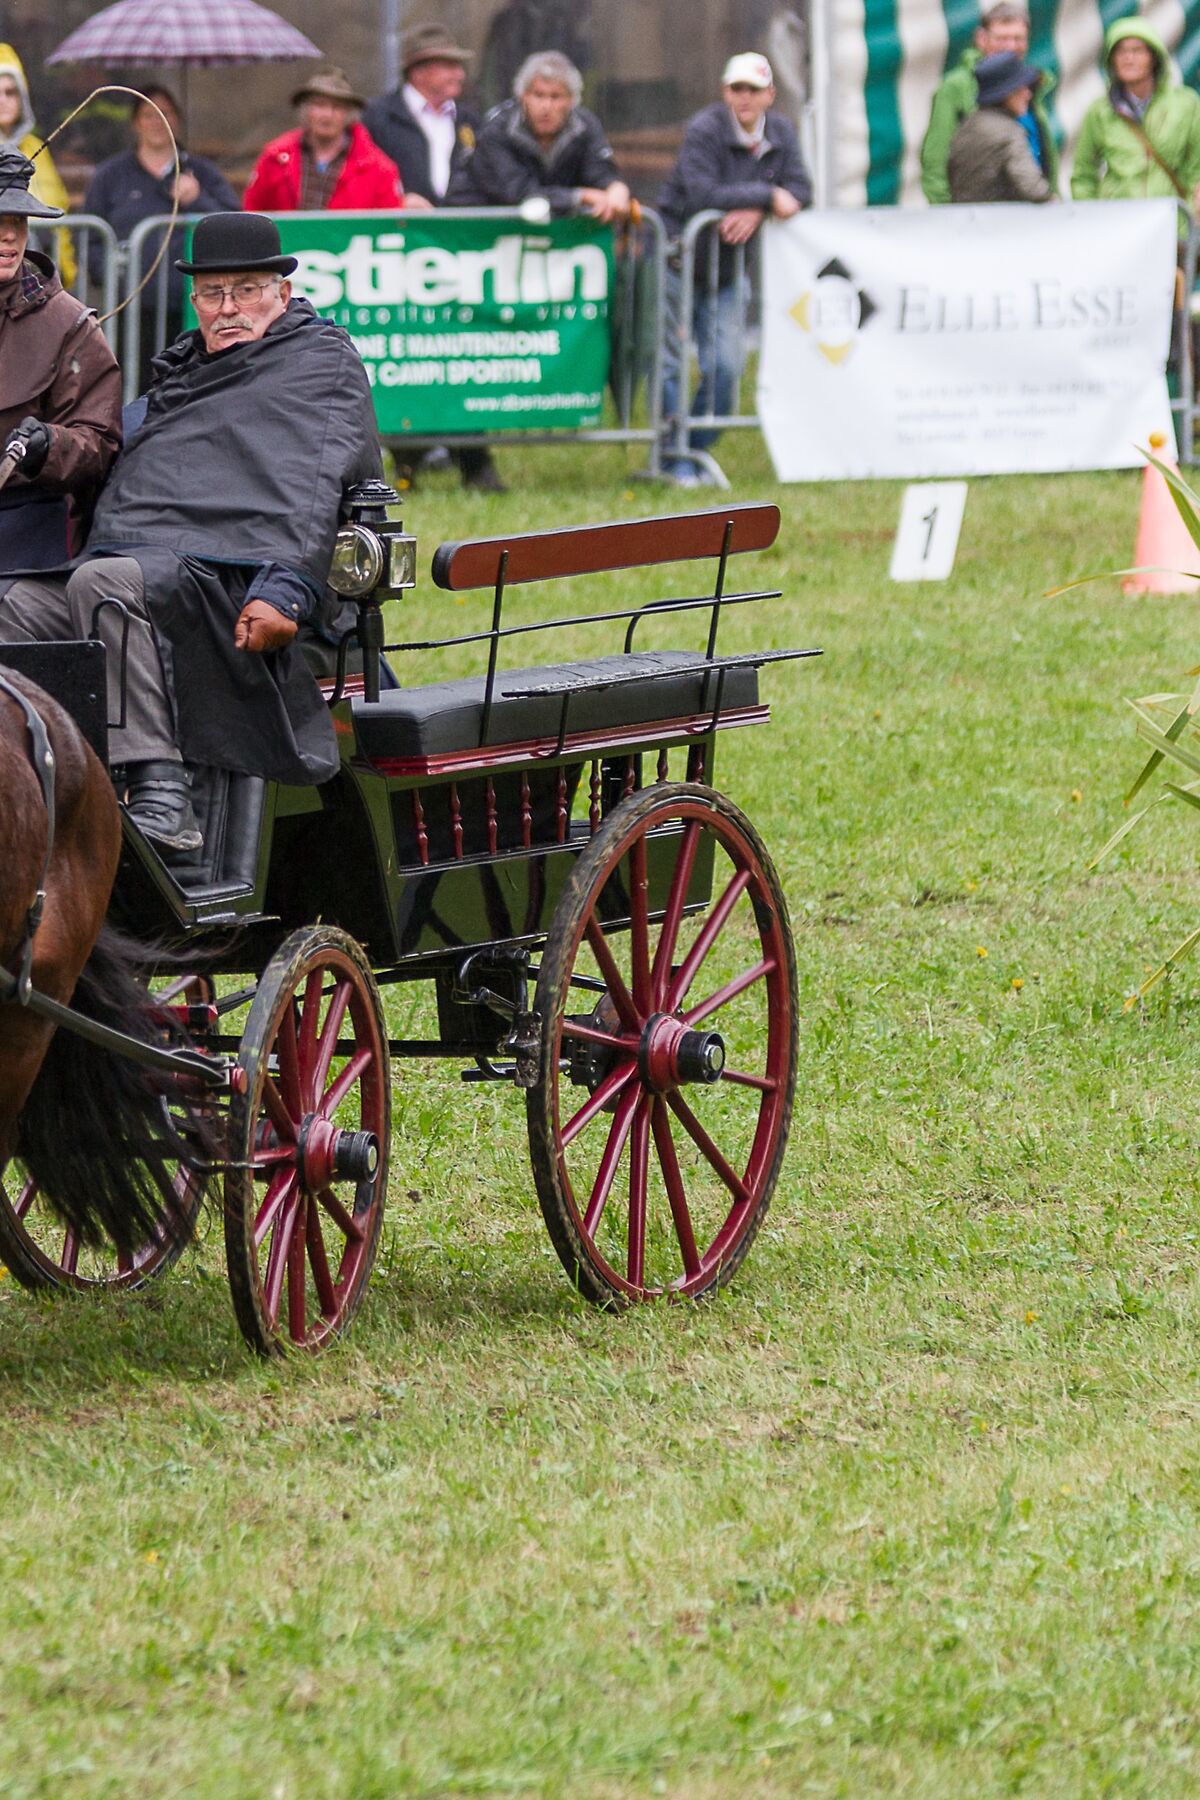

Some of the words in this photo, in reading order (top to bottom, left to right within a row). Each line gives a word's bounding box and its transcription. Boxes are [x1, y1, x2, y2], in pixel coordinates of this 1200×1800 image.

[289, 233, 608, 309] stierlin
[896, 283, 1019, 334] ELLE
[1030, 278, 1138, 330] ESSE
[406, 330, 560, 358] MANUTENZIONE
[446, 358, 541, 385] SPORTIVI
[921, 505, 938, 561] 1
